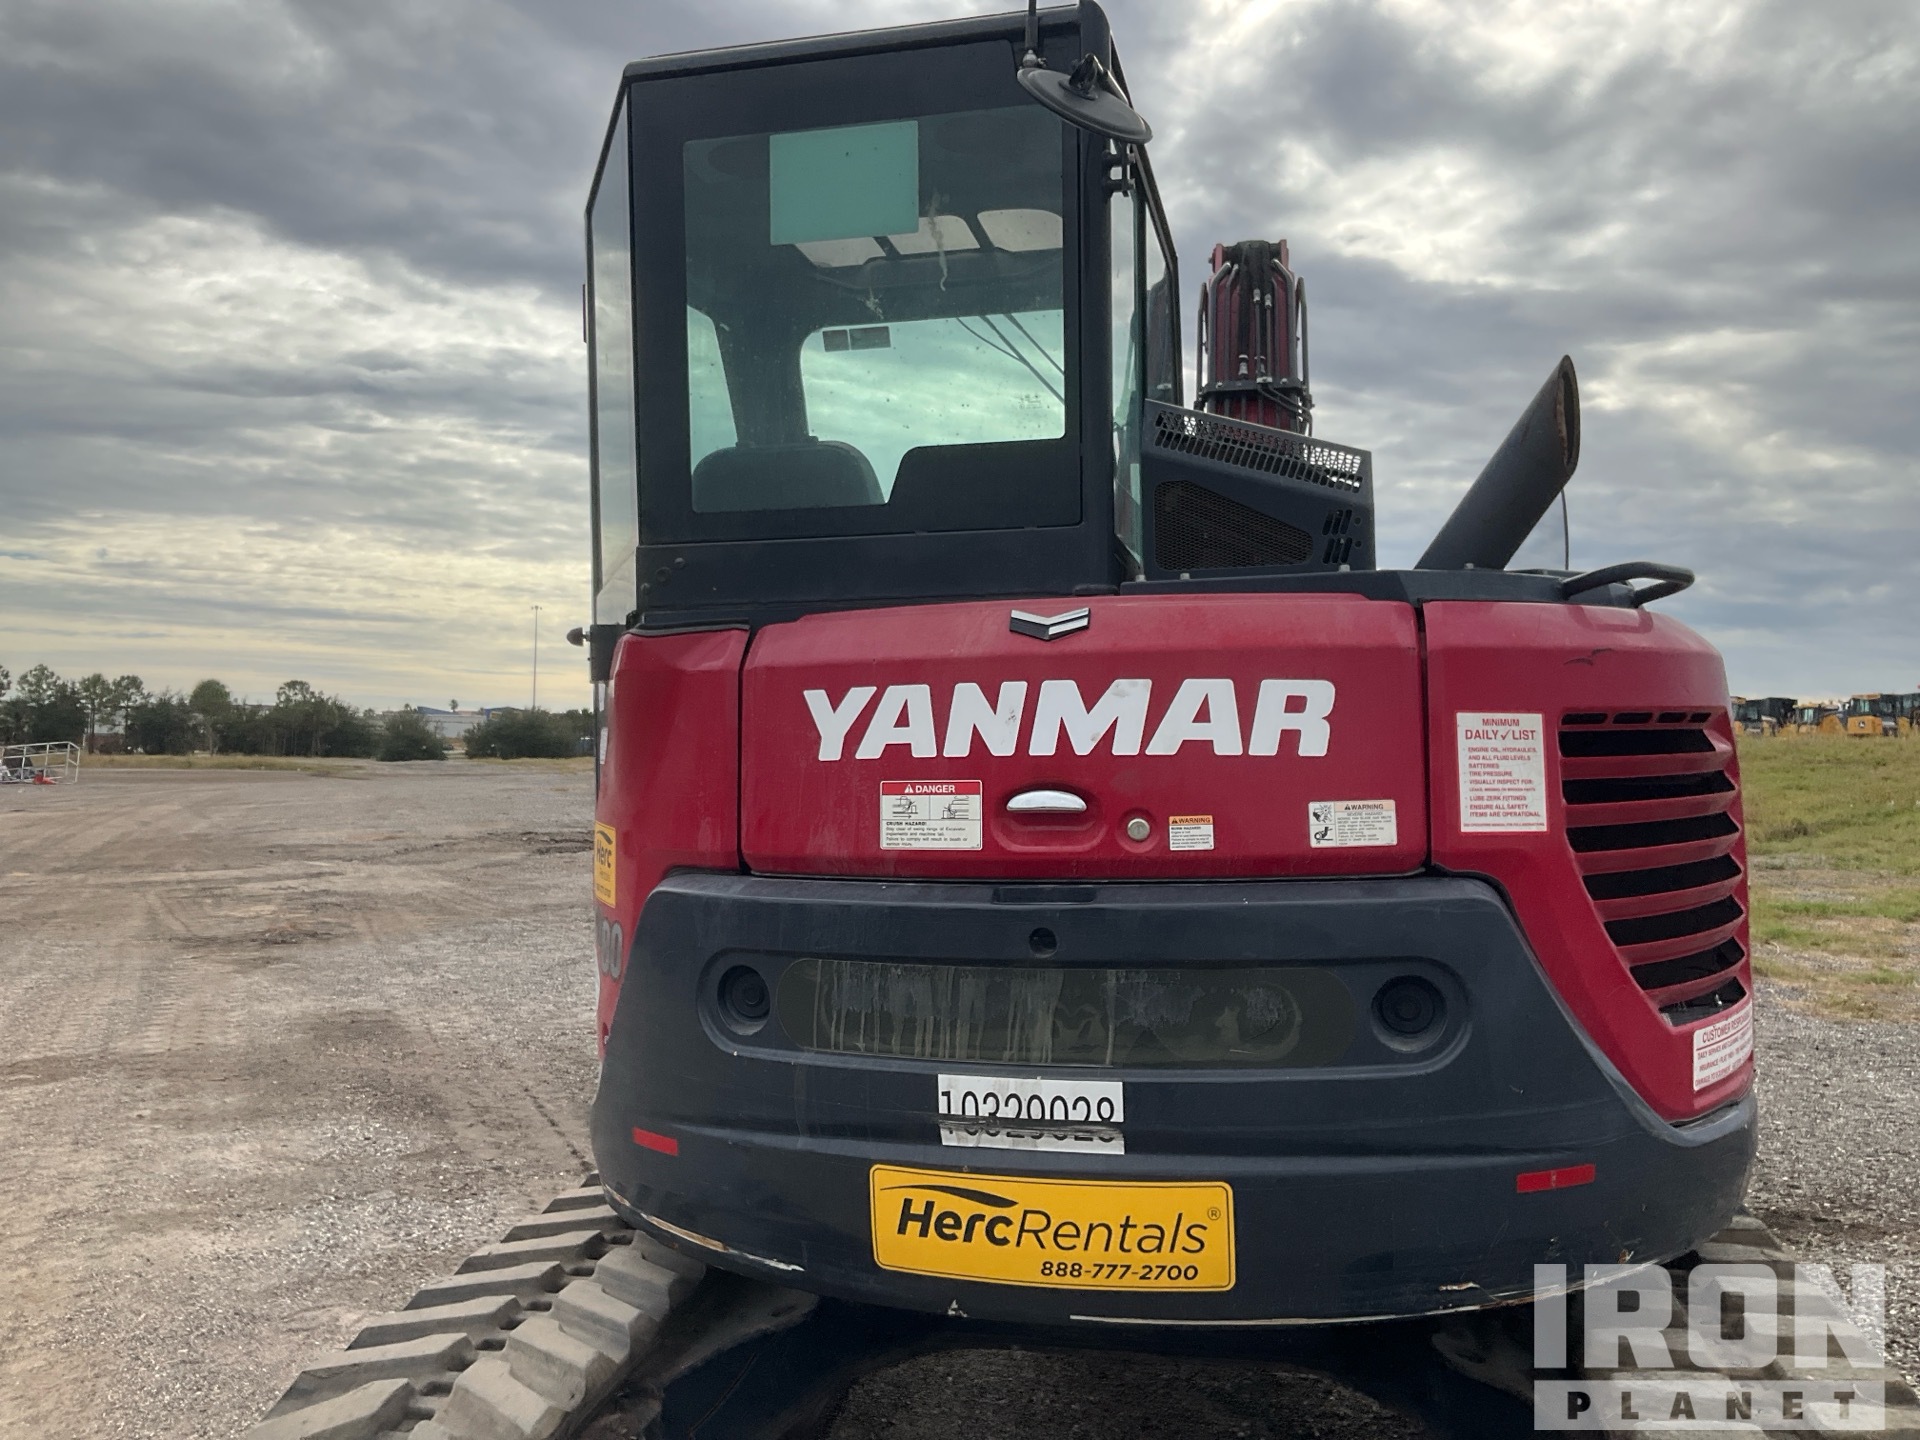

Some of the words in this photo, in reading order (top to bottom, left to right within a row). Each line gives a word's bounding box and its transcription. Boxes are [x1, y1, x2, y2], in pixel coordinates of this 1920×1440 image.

[803, 678, 1336, 761] YANMAR
[1482, 718, 1520, 727] MINIMUM
[1465, 729, 1498, 740] DAILY
[1512, 730, 1536, 740] LIST
[916, 784, 956, 793] DANGER
[596, 839, 612, 869] Herc
[1040, 1260, 1198, 1281] 888-777-2700
